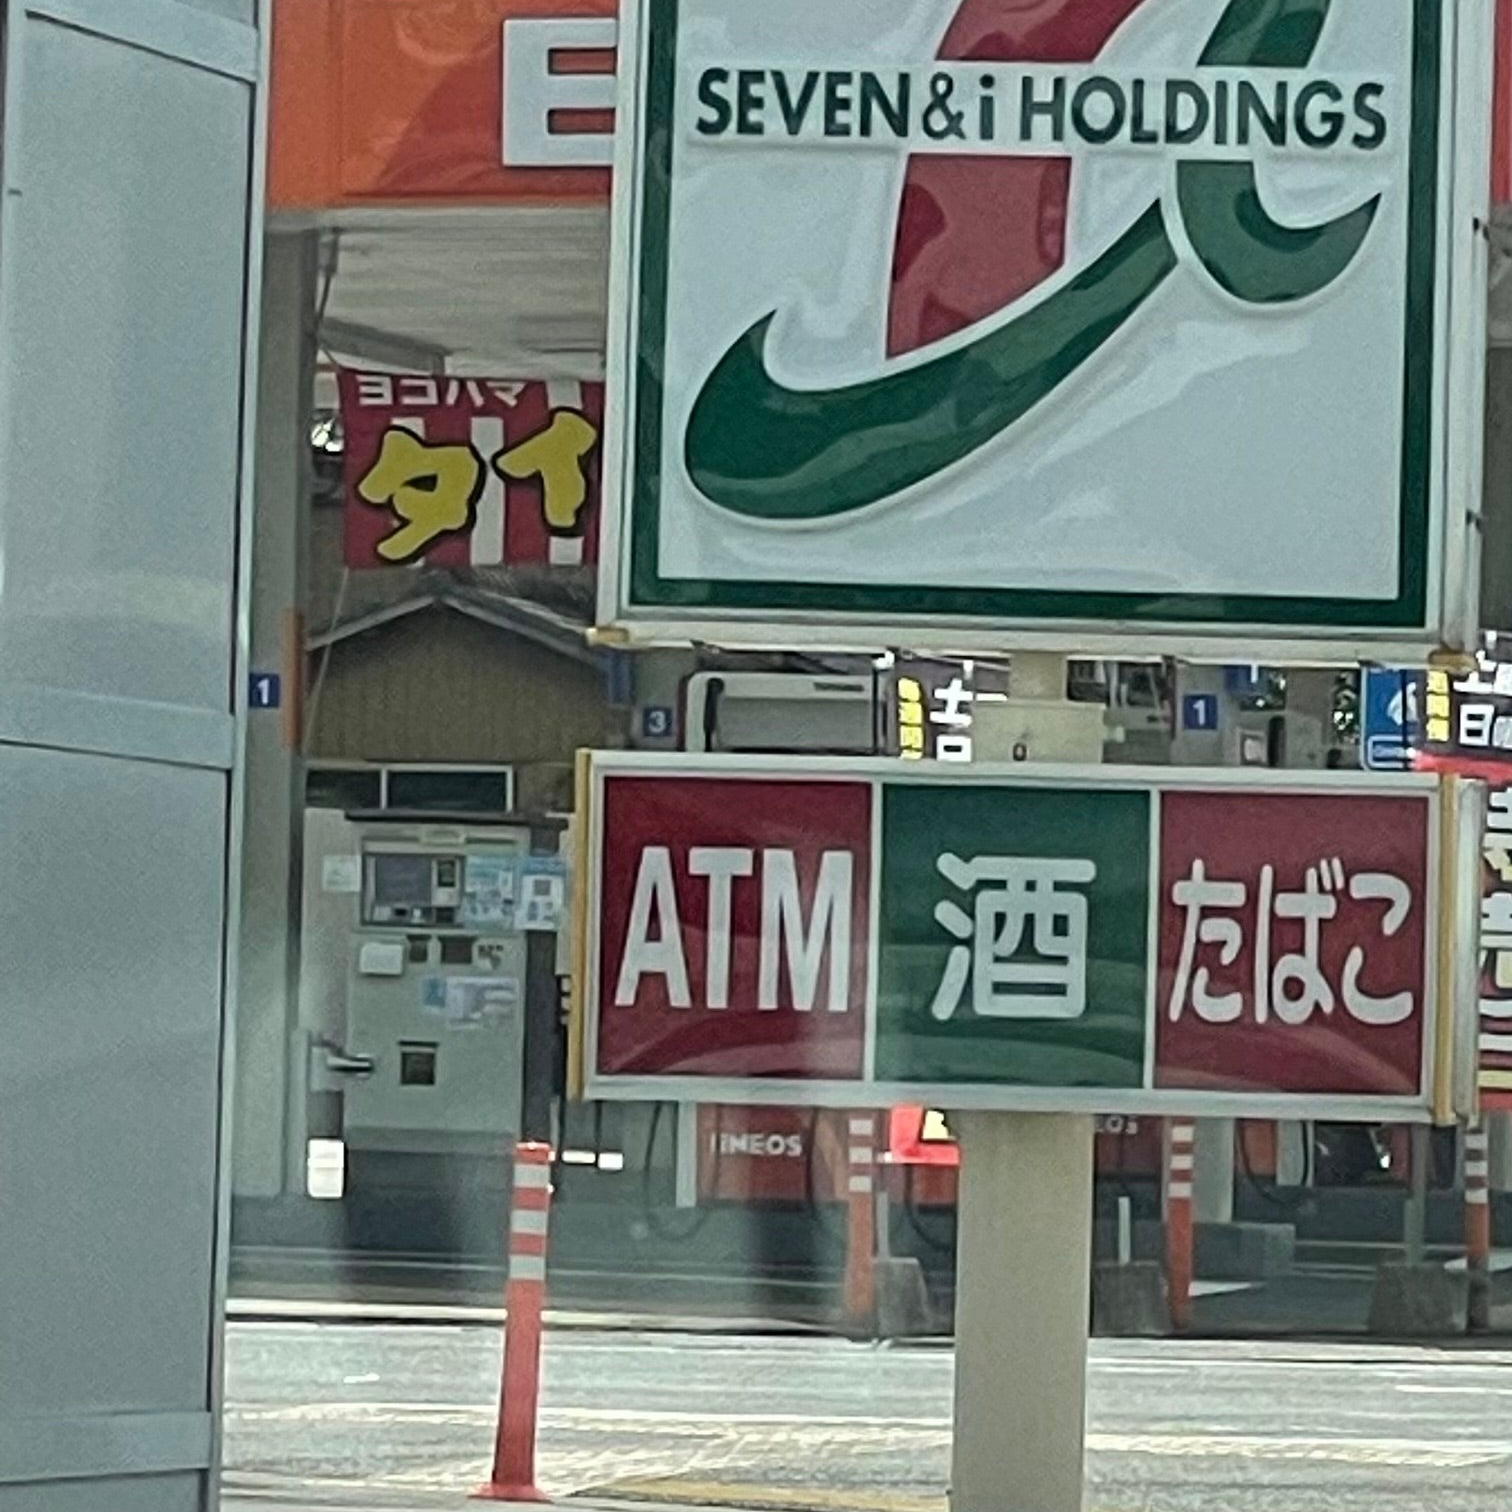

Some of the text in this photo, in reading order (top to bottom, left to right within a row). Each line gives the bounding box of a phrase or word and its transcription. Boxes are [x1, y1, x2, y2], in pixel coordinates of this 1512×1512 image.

[1019, 74, 1388, 151] HOLDINGS
[356, 374, 528, 408] ヨコハマ
[257, 677, 270, 705] 1
[1191, 699, 1206, 726] 1
[649, 713, 667, 734] 3
[614, 846, 854, 1014] ATM
[930, 851, 1096, 1022] 酒
[1168, 856, 1414, 1026] たばこ
